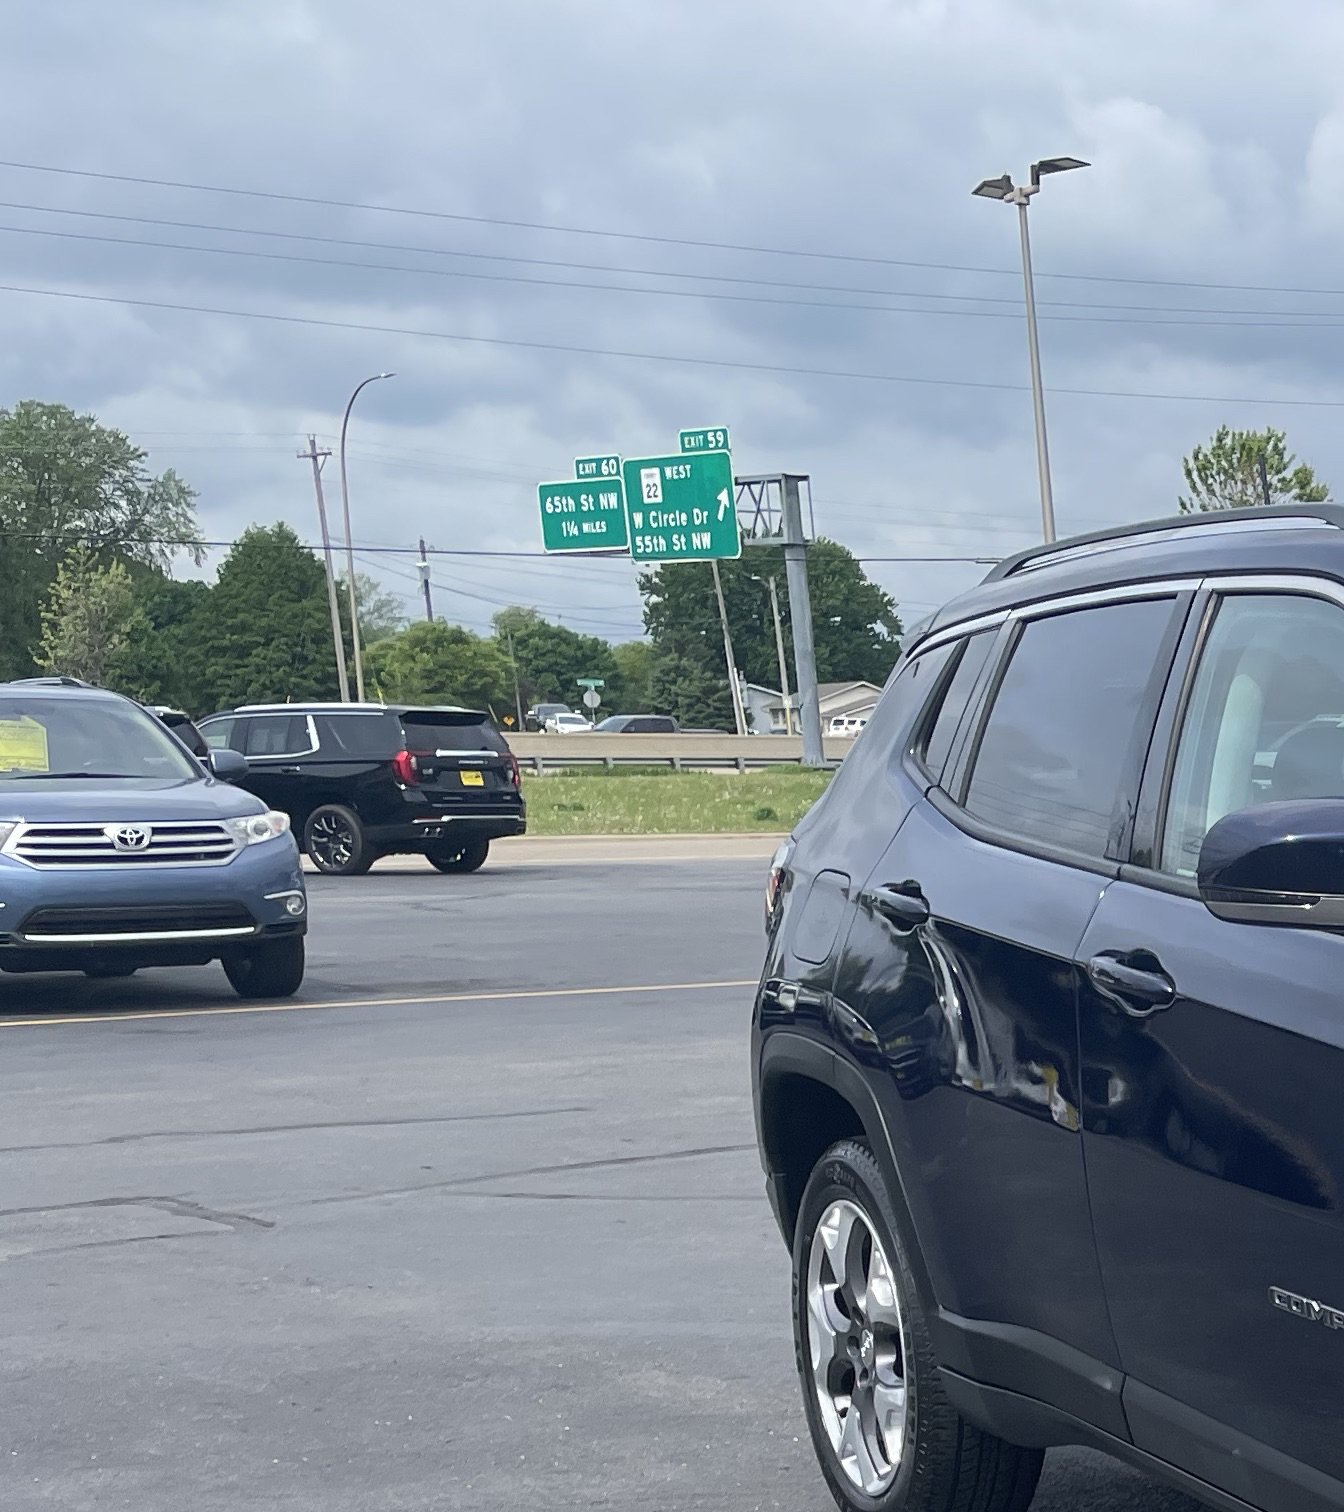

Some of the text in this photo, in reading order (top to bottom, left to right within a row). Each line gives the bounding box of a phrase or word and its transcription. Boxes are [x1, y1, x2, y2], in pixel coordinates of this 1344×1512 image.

[684, 431, 724, 449] EXIT 59
[579, 459, 617, 475] EXIT 60
[664, 465, 691, 480] WEST
[646, 483, 659, 499] 22
[545, 492, 618, 514] 65th St NW
[633, 508, 709, 529] W Circle Dr
[582, 521, 606, 534] MILES
[635, 532, 711, 554] 55th St NW
